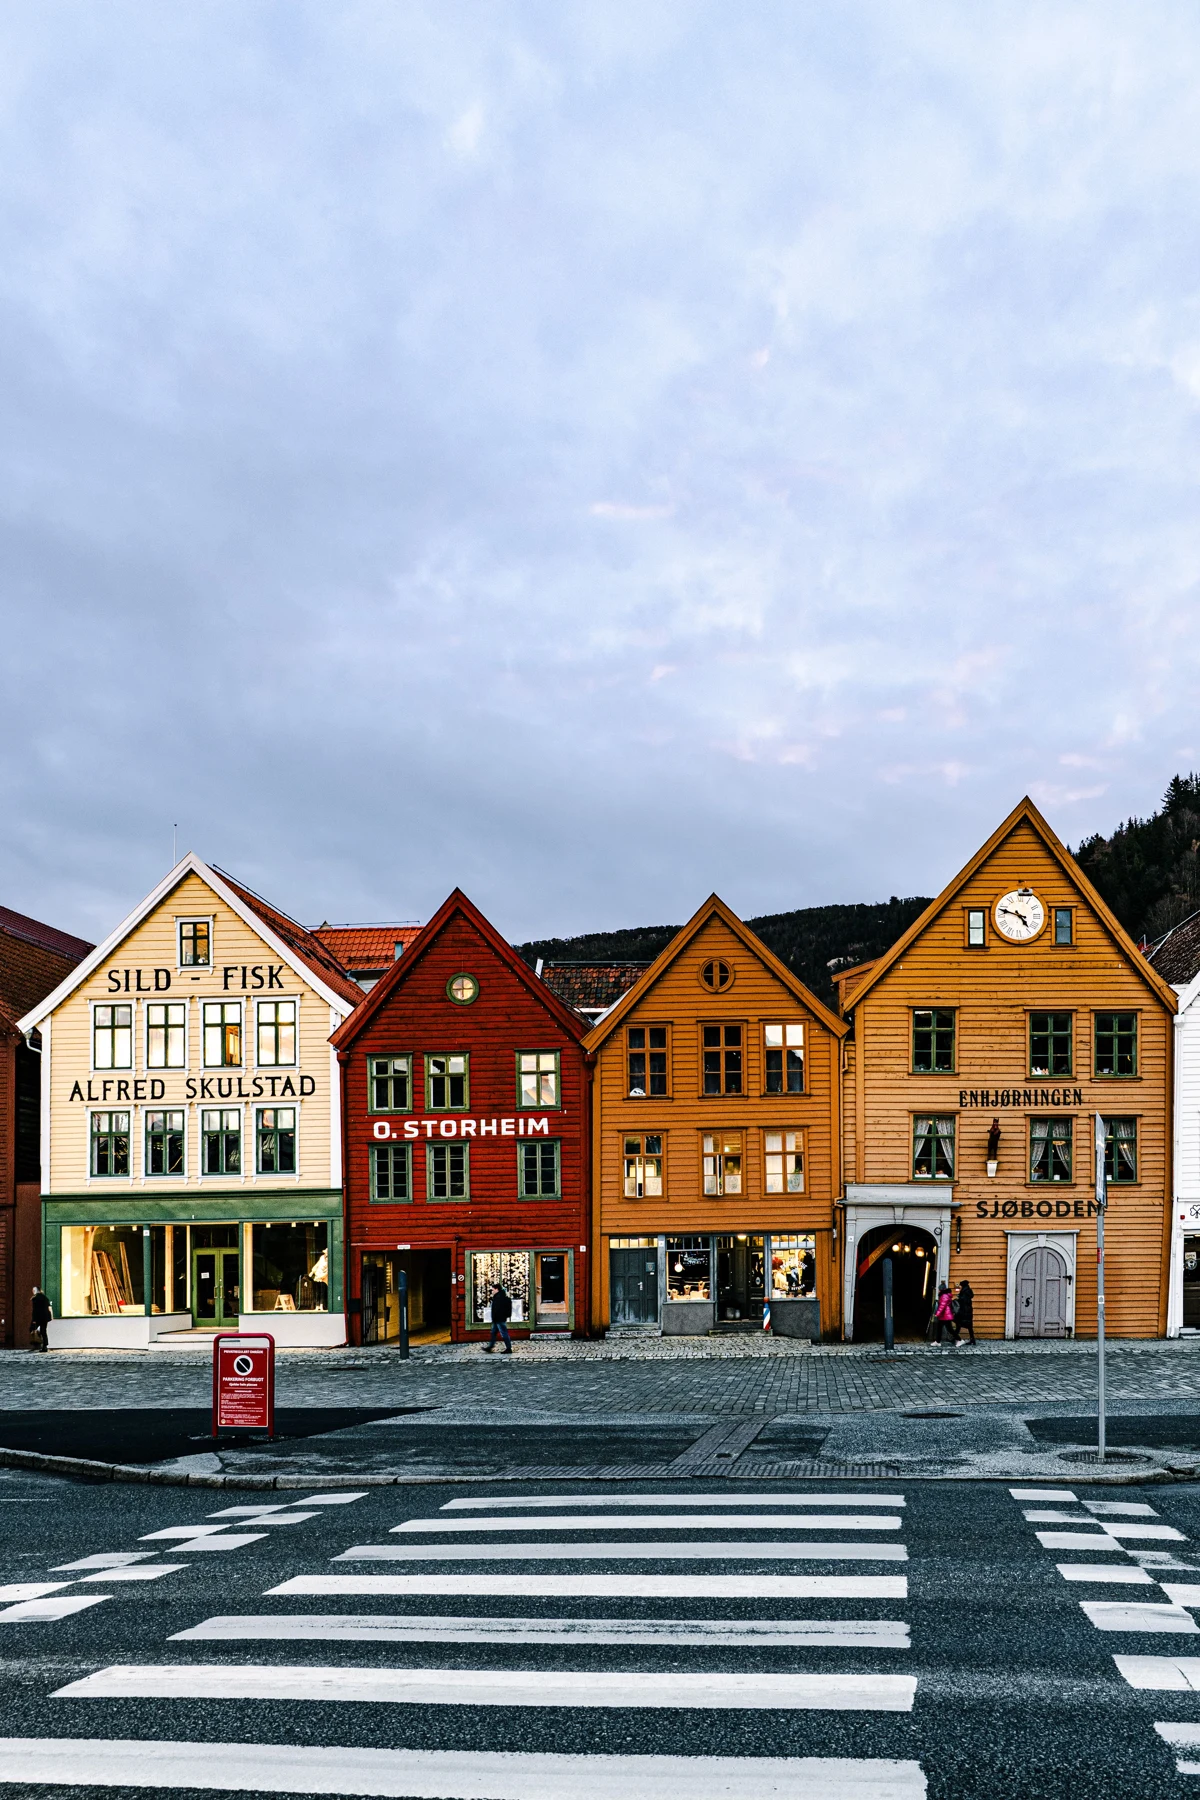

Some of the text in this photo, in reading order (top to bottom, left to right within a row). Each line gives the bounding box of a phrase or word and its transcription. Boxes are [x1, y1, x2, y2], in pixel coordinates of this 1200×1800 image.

[108, 968, 171, 993] SILD
[223, 965, 285, 990] FISK
[69, 1075, 316, 1102] ALFRED SKULSTAD
[959, 1088, 1083, 1108] ENHJØRNINGEN
[404, 1117, 549, 1138] STORHEIM
